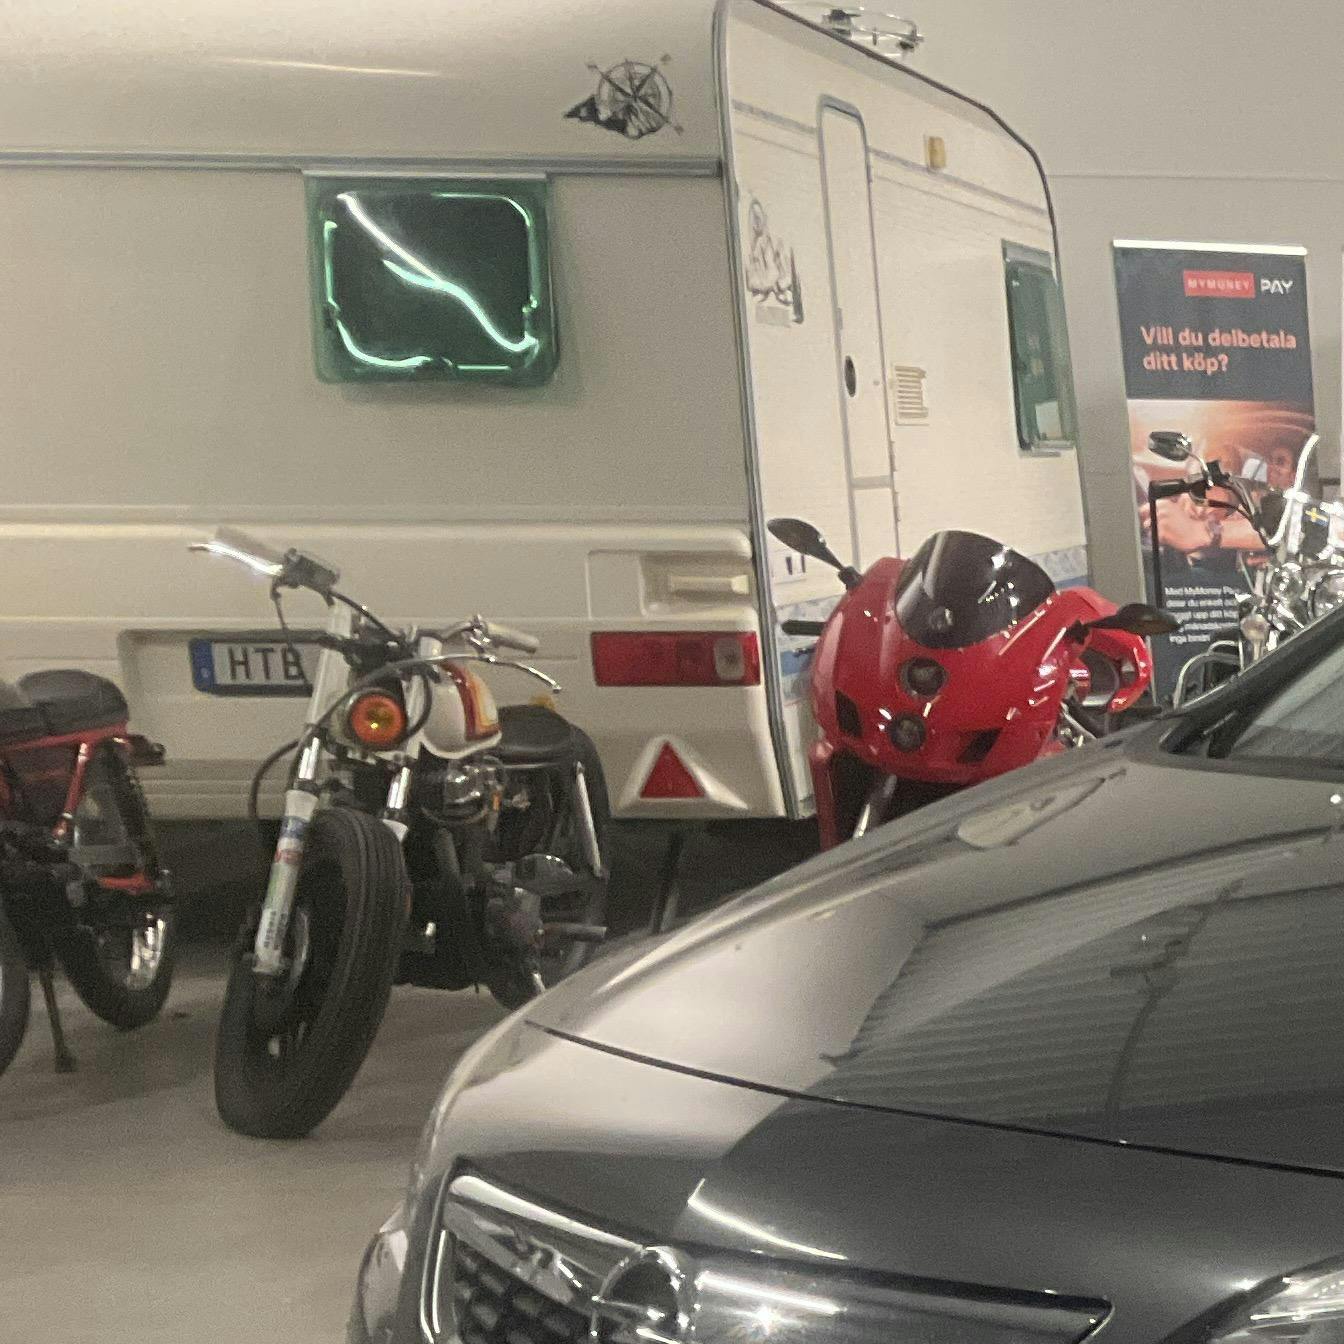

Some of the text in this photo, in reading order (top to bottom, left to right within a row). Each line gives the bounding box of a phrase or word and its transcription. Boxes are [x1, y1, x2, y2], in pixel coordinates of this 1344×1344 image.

[1260, 278, 1294, 295] PAY
[1140, 325, 1297, 349] Vill du delbetala
[1143, 351, 1229, 376] ditt köp?
